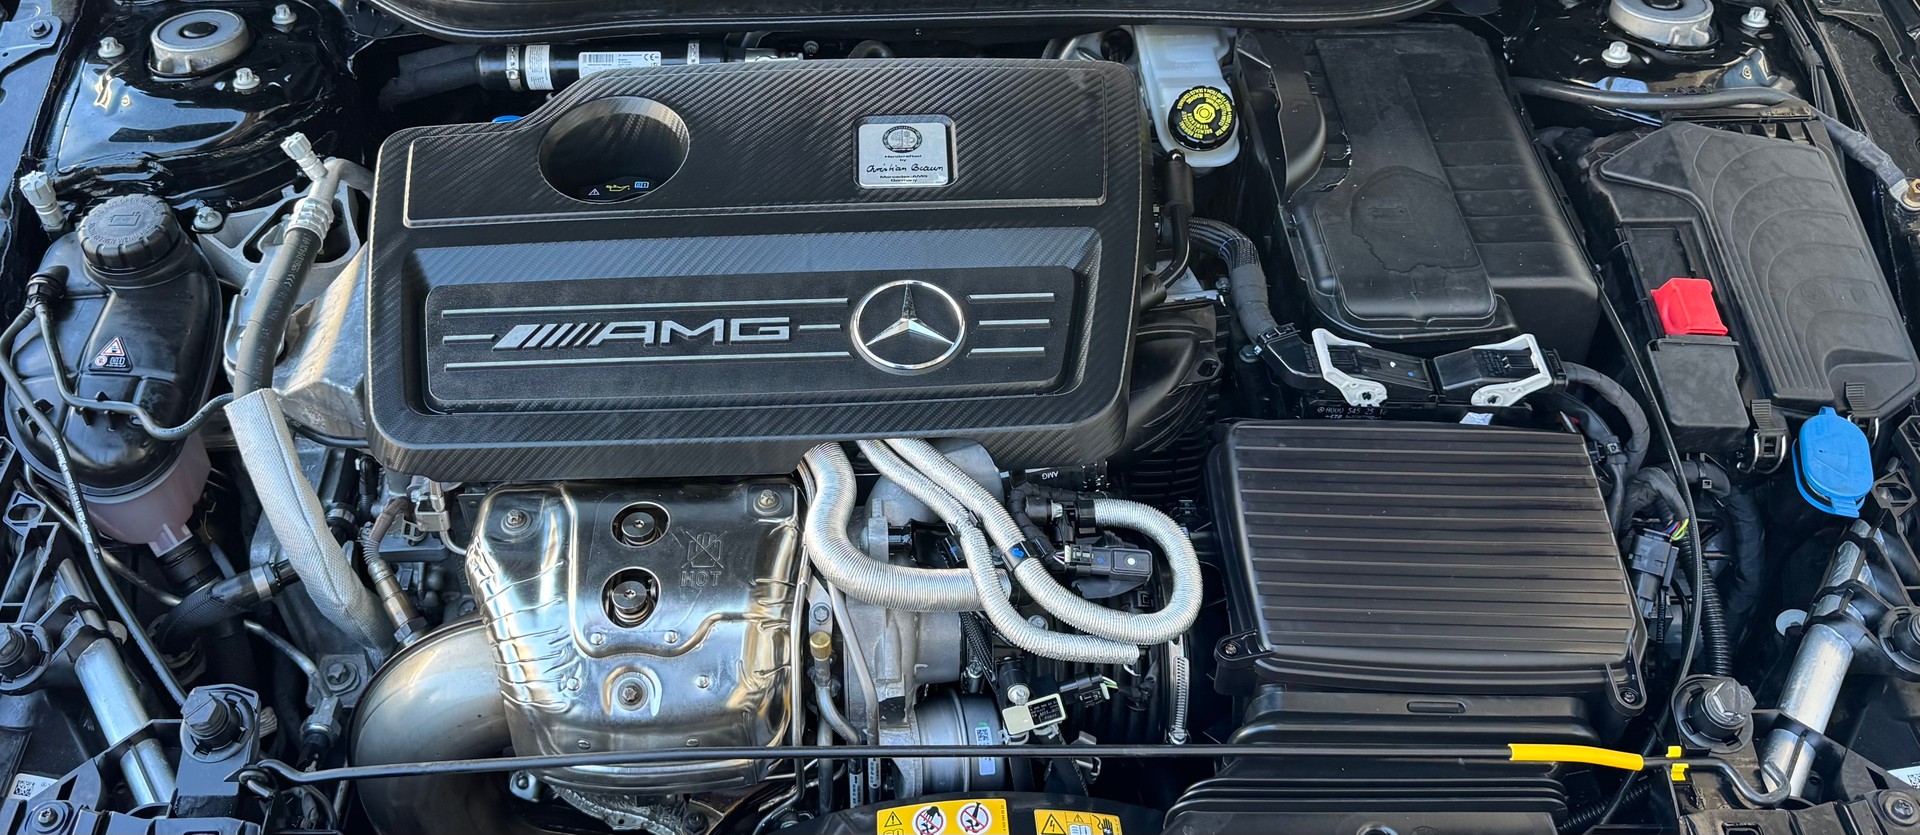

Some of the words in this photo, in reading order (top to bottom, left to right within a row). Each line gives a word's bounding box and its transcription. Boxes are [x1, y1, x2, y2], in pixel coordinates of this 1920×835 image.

[586, 316, 790, 348] AMG
[1042, 471, 1058, 479] AMG
[681, 571, 721, 586] HOT
